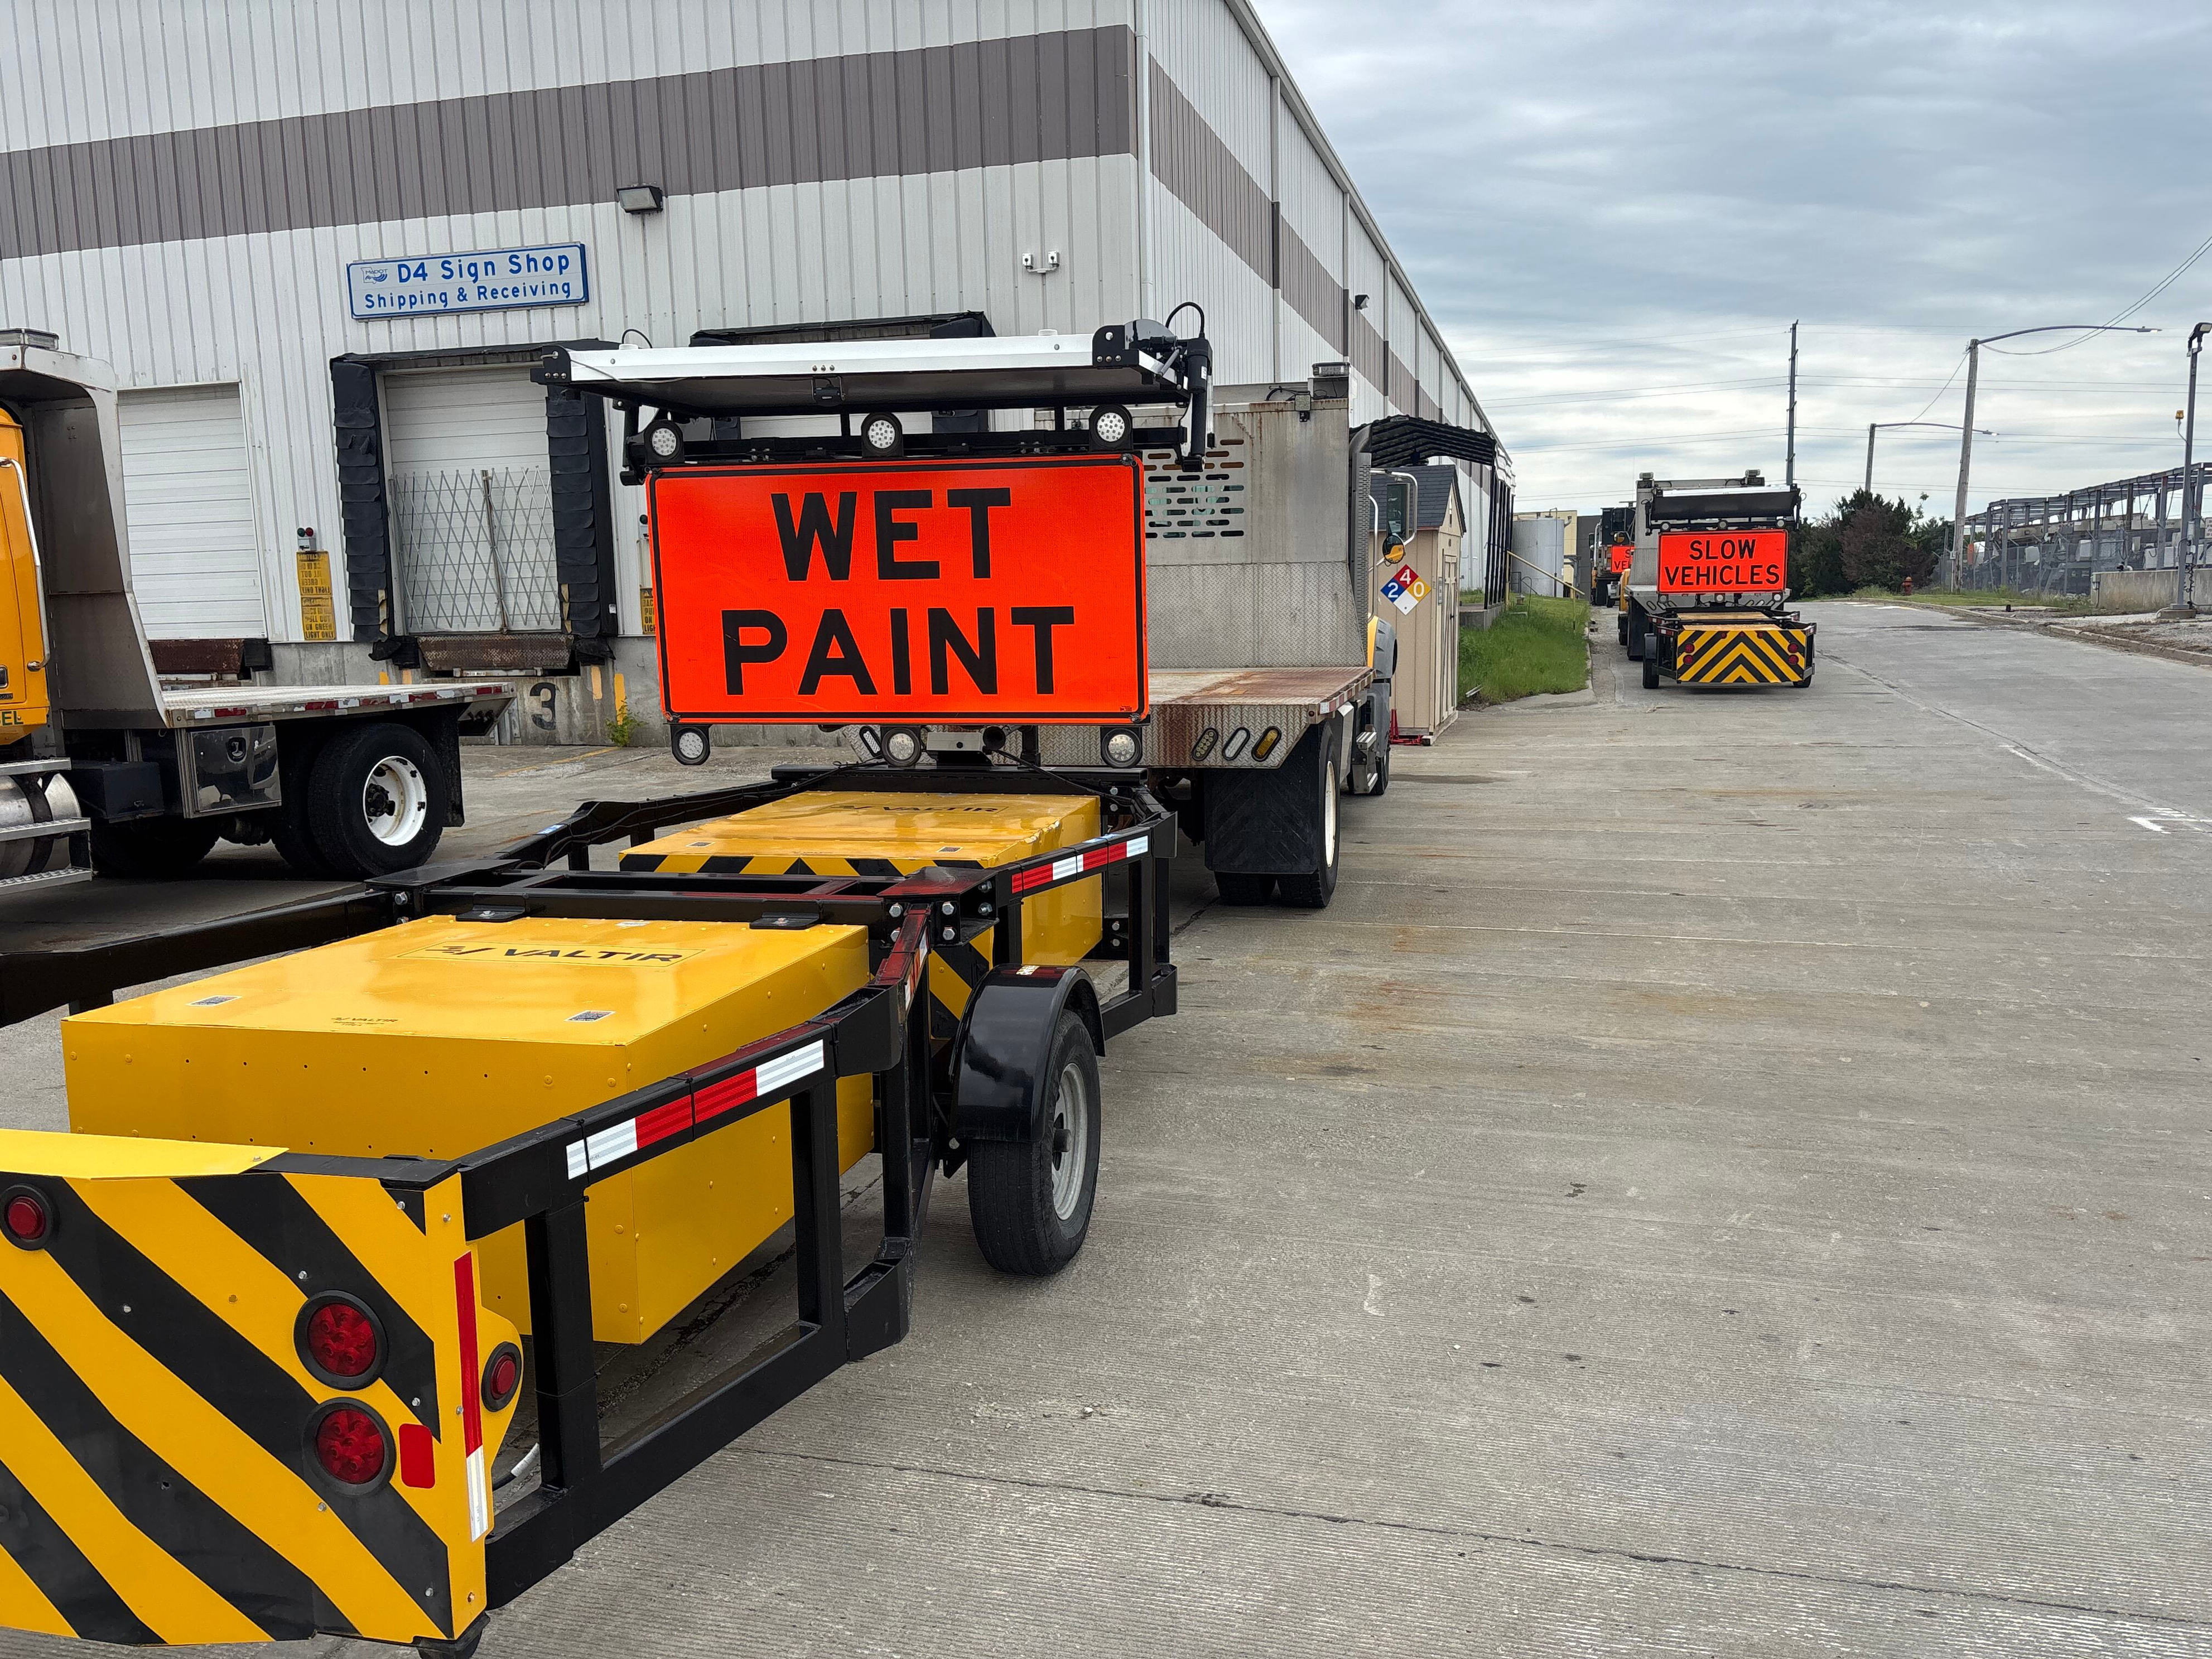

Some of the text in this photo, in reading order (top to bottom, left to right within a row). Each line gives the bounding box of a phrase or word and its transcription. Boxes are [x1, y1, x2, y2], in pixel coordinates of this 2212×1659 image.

[398, 253, 570, 283] D4 Sign Shop
[365, 281, 571, 310] Shipping & Receiving
[771, 488, 1011, 581] WET
[1689, 539, 1756, 560] SLOW
[1399, 569, 1411, 585] 4
[1665, 564, 1780, 586] VEHICLES
[1388, 582, 1399, 598] 2
[1414, 581, 1424, 597] 0
[721, 606, 1074, 696] PAINT
[530, 682, 560, 730] 3
[0, 711, 23, 726] EL
[504, 949, 682, 962] VALTIR
